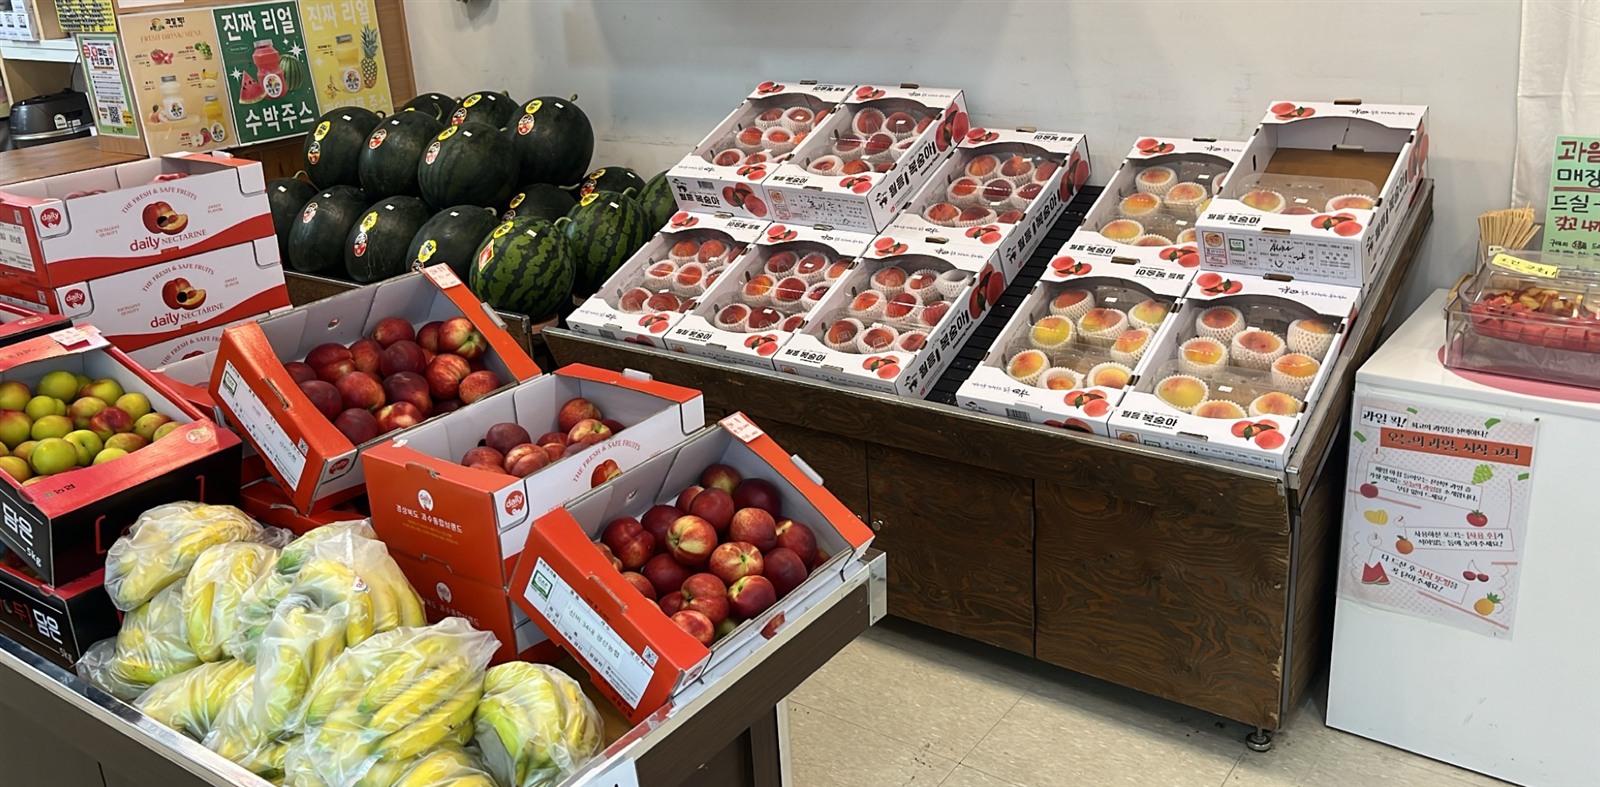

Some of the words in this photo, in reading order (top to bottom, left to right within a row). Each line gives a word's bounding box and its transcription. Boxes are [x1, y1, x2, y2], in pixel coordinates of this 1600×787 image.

[221, 11, 257, 42] 진짜
[261, 6, 295, 35] 리얼
[307, 2, 338, 31] 진짜
[246, 102, 315, 136] 수박주스
[908, 141, 936, 176] 복숭아
[122, 202, 133, 214] THE
[132, 190, 152, 204] FRESH
[176, 188, 198, 201] FRUITS
[1036, 189, 1061, 228] 복숭아
[1551, 195, 1589, 213] 드실
[41, 210, 59, 223] daily
[1207, 213, 1226, 221] 월등
[1227, 213, 1261, 224] 복숭아
[130, 236, 160, 251] daily
[161, 229, 208, 245] NECTARINE
[1086, 245, 1116, 255] 복숭아
[142, 281, 153, 292] THE
[152, 268, 171, 282] FRESH
[194, 264, 214, 275] FRUITS
[66, 290, 84, 302] daily
[150, 312, 180, 328] daily
[180, 302, 225, 321] NECTARINE
[940, 310, 970, 351] 복숭아
[161, 353, 171, 365] THE
[171, 340, 189, 356] FRESH
[800, 350, 827, 362] 복숭아
[1121, 410, 1140, 420] 월등
[1142, 413, 1178, 428] 복숭아
[1363, 410, 1387, 425] 과일
[1390, 415, 1407, 428] 픽!
[1412, 422, 1432, 431] 최고의
[1433, 424, 1455, 434] 과일을
[1388, 432, 1425, 447] 오늘의
[1463, 443, 1488, 456] 시식
[1492, 448, 1520, 460] 코너
[573, 470, 583, 483] THE
[582, 449, 602, 470] FRESH
[607, 440, 622, 449] SAFE
[622, 439, 641, 452] FRUITS
[1402, 479, 1422, 490] 오늘의
[1422, 483, 1442, 493] 과일을
[506, 493, 523, 508] daily
[2, 502, 34, 547] 담은
[396, 504, 419, 519] 경상북도
[421, 512, 463, 534] 과수통합브랜드
[26, 550, 43, 568] 5kg
[1418, 568, 1434, 580] 시식
[33, 609, 63, 645] 담은
